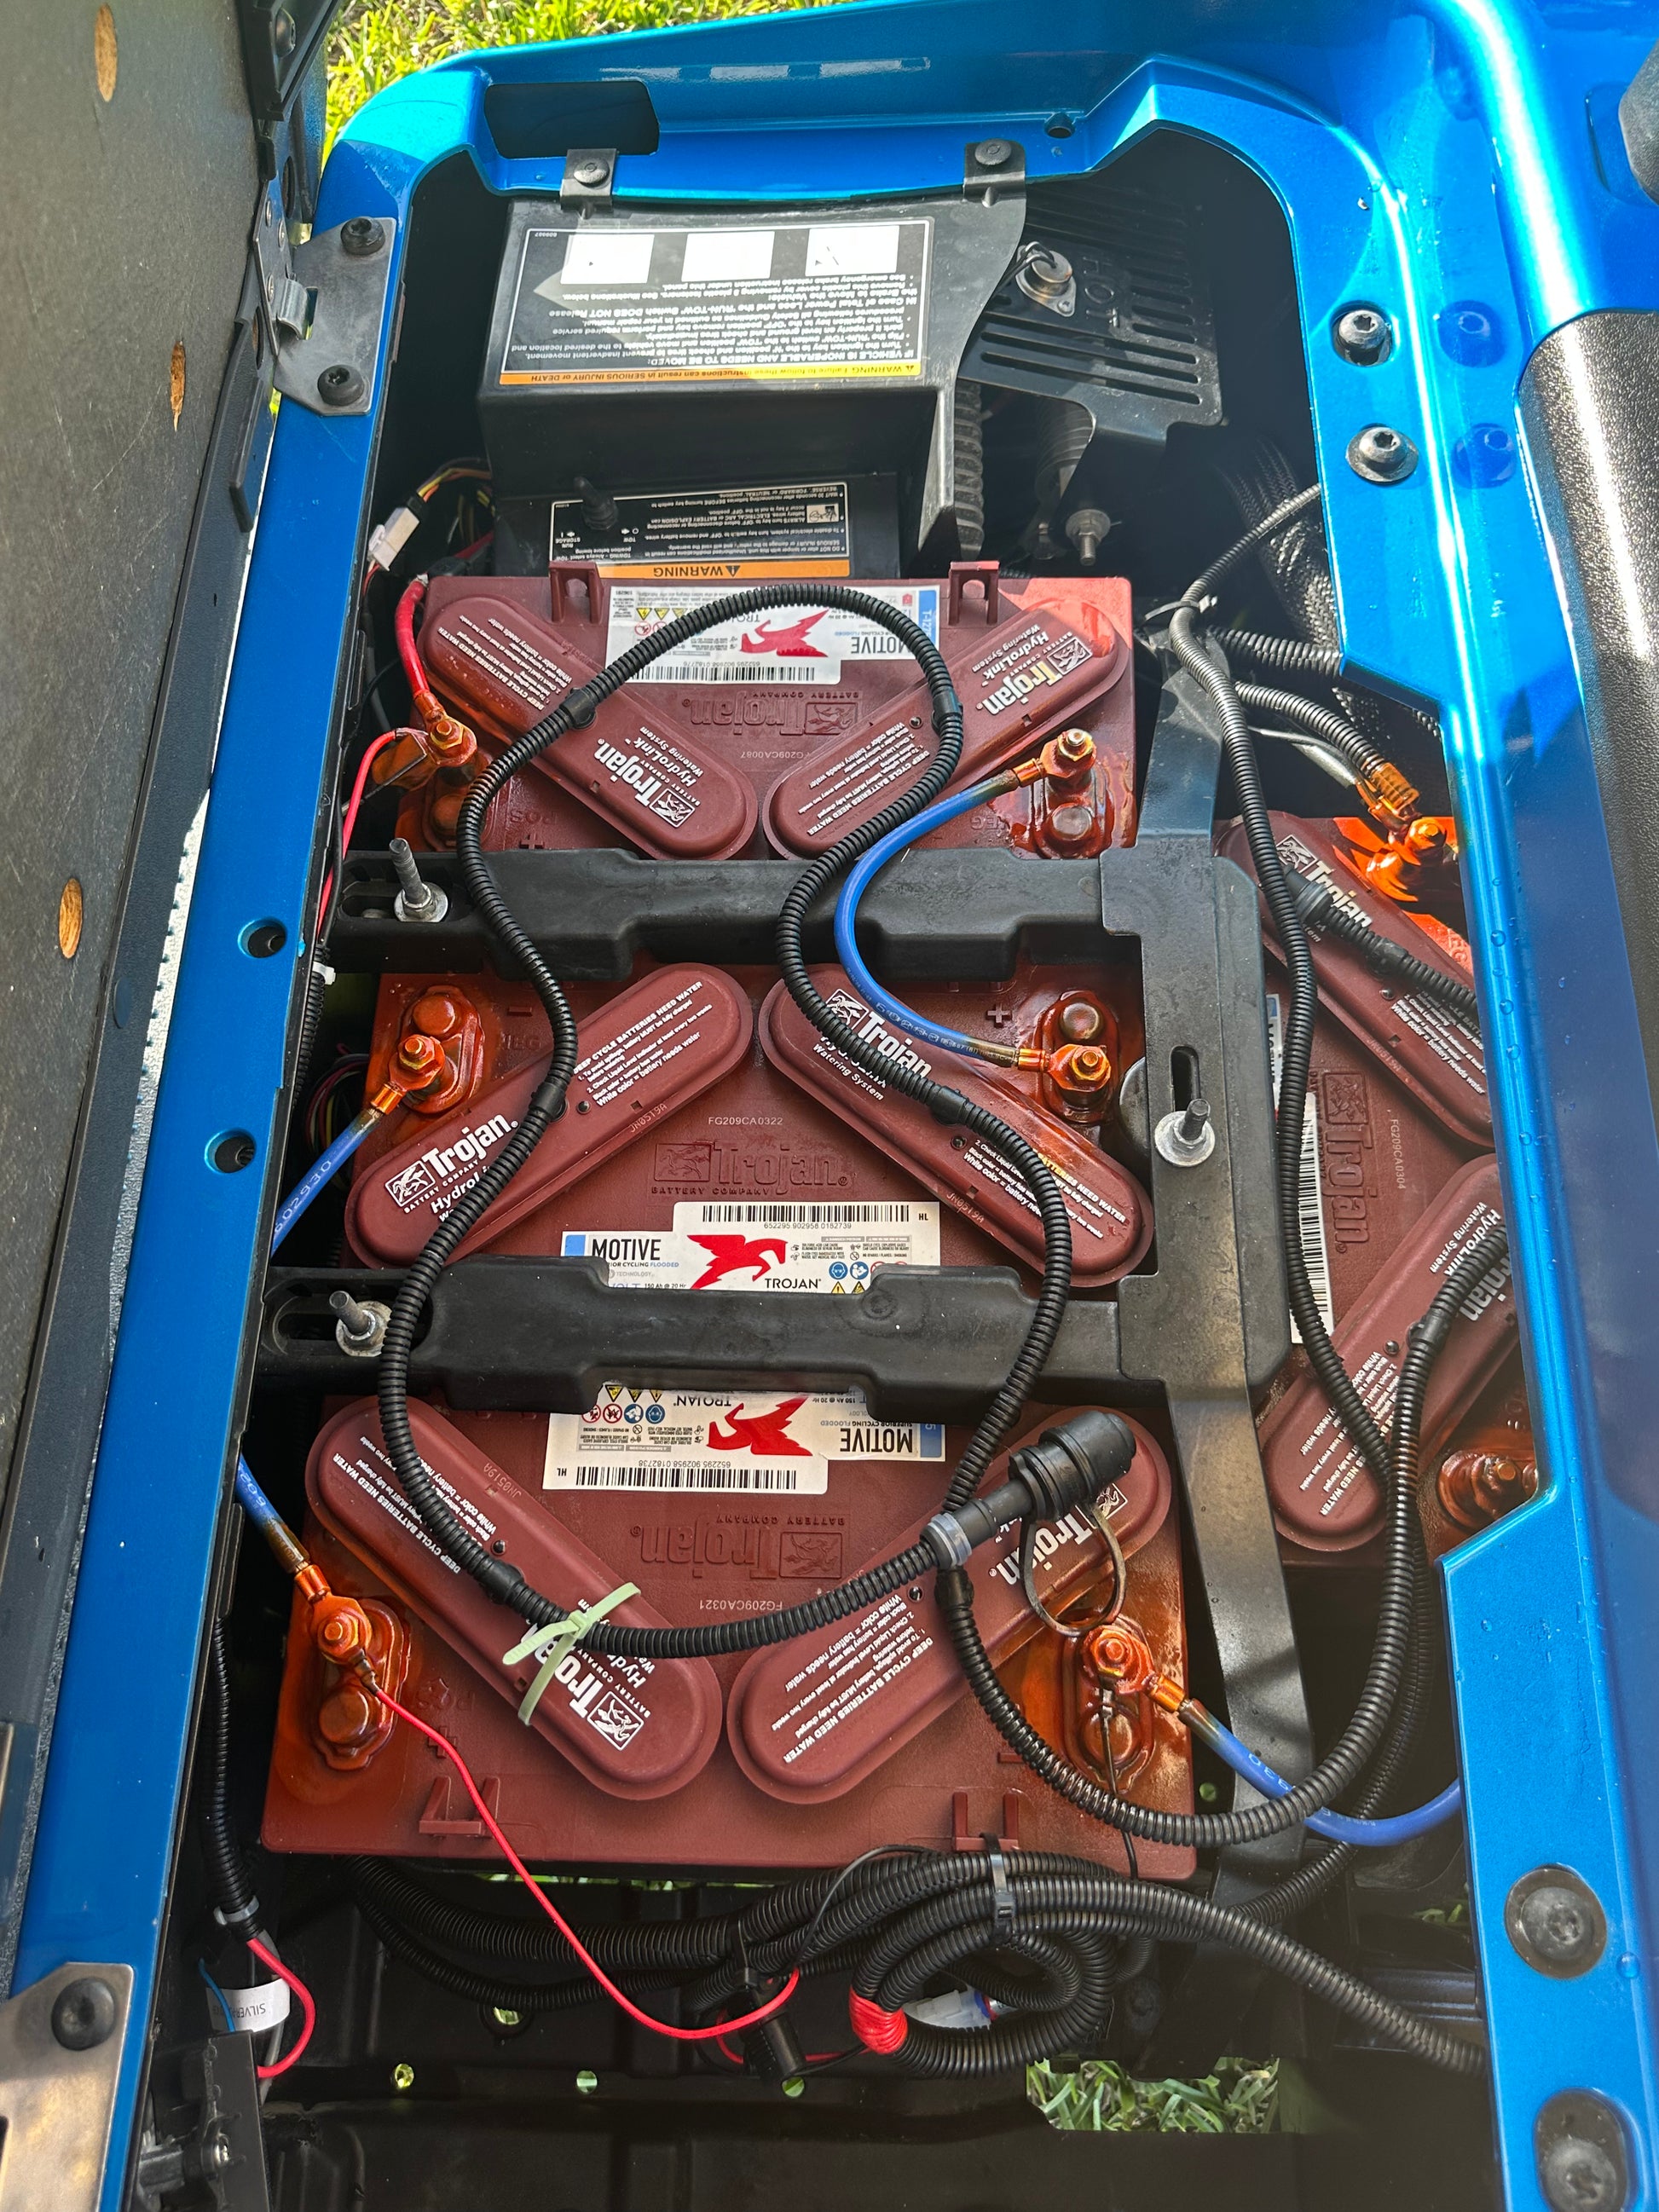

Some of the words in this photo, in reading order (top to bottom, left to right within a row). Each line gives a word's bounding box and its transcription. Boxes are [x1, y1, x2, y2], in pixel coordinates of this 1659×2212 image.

[852, 366, 903, 374] WARNING
[654, 565, 724, 579] WARNING
[437, 627, 460, 646] WATER
[1003, 623, 1042, 653] Watering
[458, 642, 477, 659] NEED
[971, 648, 1004, 673] System
[475, 655, 510, 684] BATTERIES
[507, 679, 529, 699] CYCLE
[527, 695, 546, 711] DEEP
[639, 725, 670, 752] System
[668, 747, 705, 778] Watering
[910, 750, 931, 766] DEEP
[640, 759, 671, 784] COMPANY
[887, 762, 913, 782] CYCLE
[671, 783, 702, 807] BATTERY
[850, 777, 890, 807] BATTERIES
[832, 803, 853, 819] NEED
[806, 816, 834, 836] WATER
[591, 1040, 617, 1061] CYCLE
[616, 1012, 657, 1044] BATTERIES
[656, 998, 677, 1016] NEED
[675, 979, 703, 1002] WATER
[1390, 1002, 1408, 1023] White
[1407, 1019, 1425, 1037] color
[1427, 1039, 1448, 1062] battery
[1447, 1059, 1468, 1080] needs
[1466, 1076, 1486, 1095] water
[596, 1089, 618, 1108] White
[615, 1077, 635, 1094] color
[638, 1057, 663, 1078] battery
[660, 1042, 683, 1062] needs
[680, 1030, 702, 1048] water
[812, 1043, 852, 1076] Watering
[851, 1073, 884, 1100] System
[708, 1117, 783, 1126] FG209CA0322
[404, 1187, 440, 1215] BATTERY
[442, 1159, 479, 1188] COMPANY
[1075, 1183, 1099, 1203] NEED
[1096, 1198, 1127, 1223] WATER
[918, 1213, 929, 1222] HL
[1453, 1201, 1488, 1241] Watering
[592, 1239, 662, 1261] MOTIVE
[1429, 1239, 1458, 1274] System
[765, 1278, 818, 1289] TROJAN
[1361, 1350, 1381, 1373] White
[1313, 1412, 1332, 1437] needs
[839, 1428, 913, 1453] MOTIVE
[1299, 1434, 1316, 1457] water
[332, 1453, 361, 1480] WATER
[556, 1467, 567, 1476] HL
[1339, 1465, 1359, 1490] NEED
[357, 1476, 381, 1499] NEED
[483, 1462, 521, 1498] JN0519A
[1319, 1486, 1344, 1517] WATER
[377, 1494, 419, 1534] BATTERIES
[415, 1530, 443, 1556] CYCLE
[440, 1552, 463, 1574] DEEP
[699, 1599, 783, 1611] FG209CA0321
[877, 1593, 903, 1616] White
[905, 1611, 916, 1621] 2.
[858, 1610, 882, 1632] color
[888, 1615, 910, 1635] Check
[827, 1631, 856, 1657] battery
[872, 1630, 893, 1649] Liquid
[910, 1637, 934, 1659] DEEP
[804, 1651, 831, 1676] needs
[857, 1643, 876, 1661] Level
[577, 1648, 614, 1683] COMPANY
[834, 1655, 861, 1680] Indicator
[882, 1655, 913, 1683] CYCLE
[783, 1671, 808, 1694] water
[814, 1679, 832, 1696] least
[828, 1674, 838, 1685] at
[615, 1684, 650, 1718] BATTERY
[799, 1690, 818, 1709] every
[836, 1678, 885, 1720] BATTERIES
[771, 1712, 792, 1732] weeks
[789, 1704, 802, 1718] two
[813, 1715, 840, 1740] NEED
[783, 1735, 816, 1764] WATER
